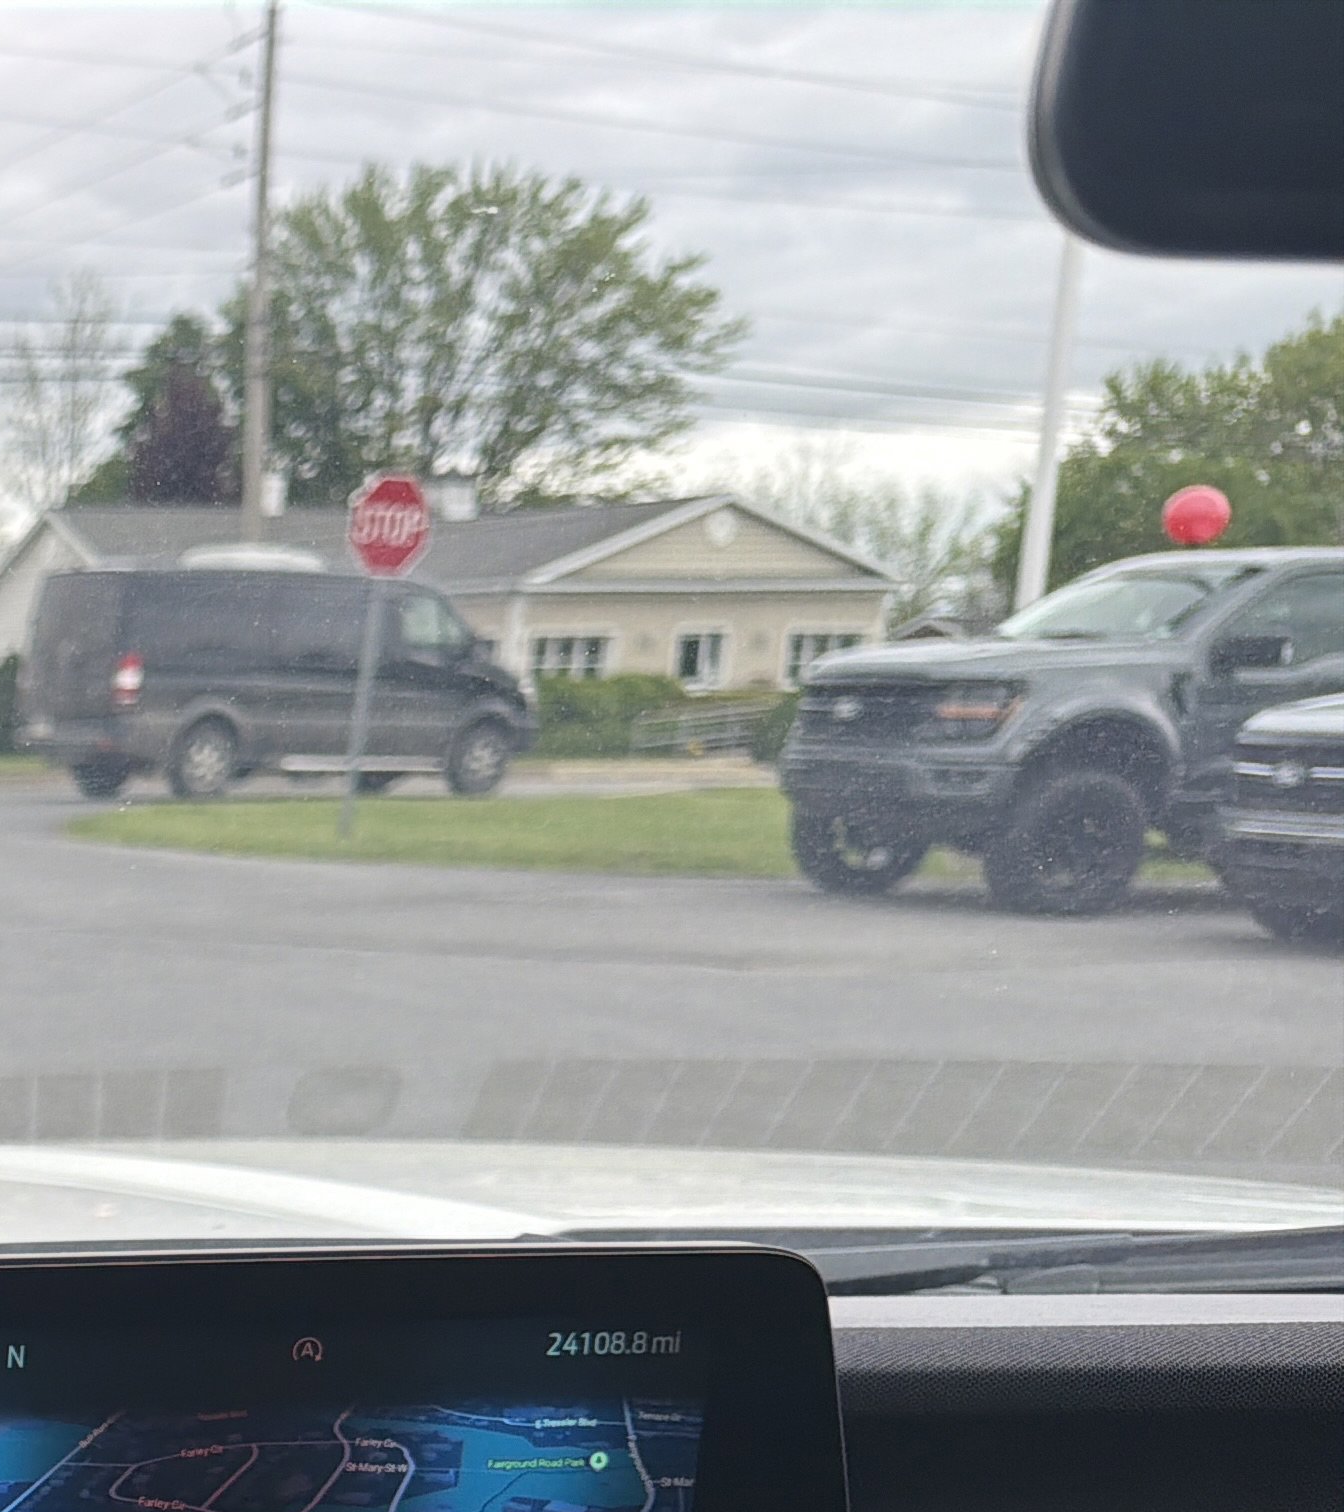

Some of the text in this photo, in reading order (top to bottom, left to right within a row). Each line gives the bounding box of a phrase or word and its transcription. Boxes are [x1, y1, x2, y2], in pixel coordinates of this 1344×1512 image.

[353, 502, 423, 544] STOP
[546, 1331, 681, 1356] 24108.8 mi
[7, 1345, 25, 1368] N
[539, 1458, 563, 1468] Road
[564, 1457, 585, 1467] Park
